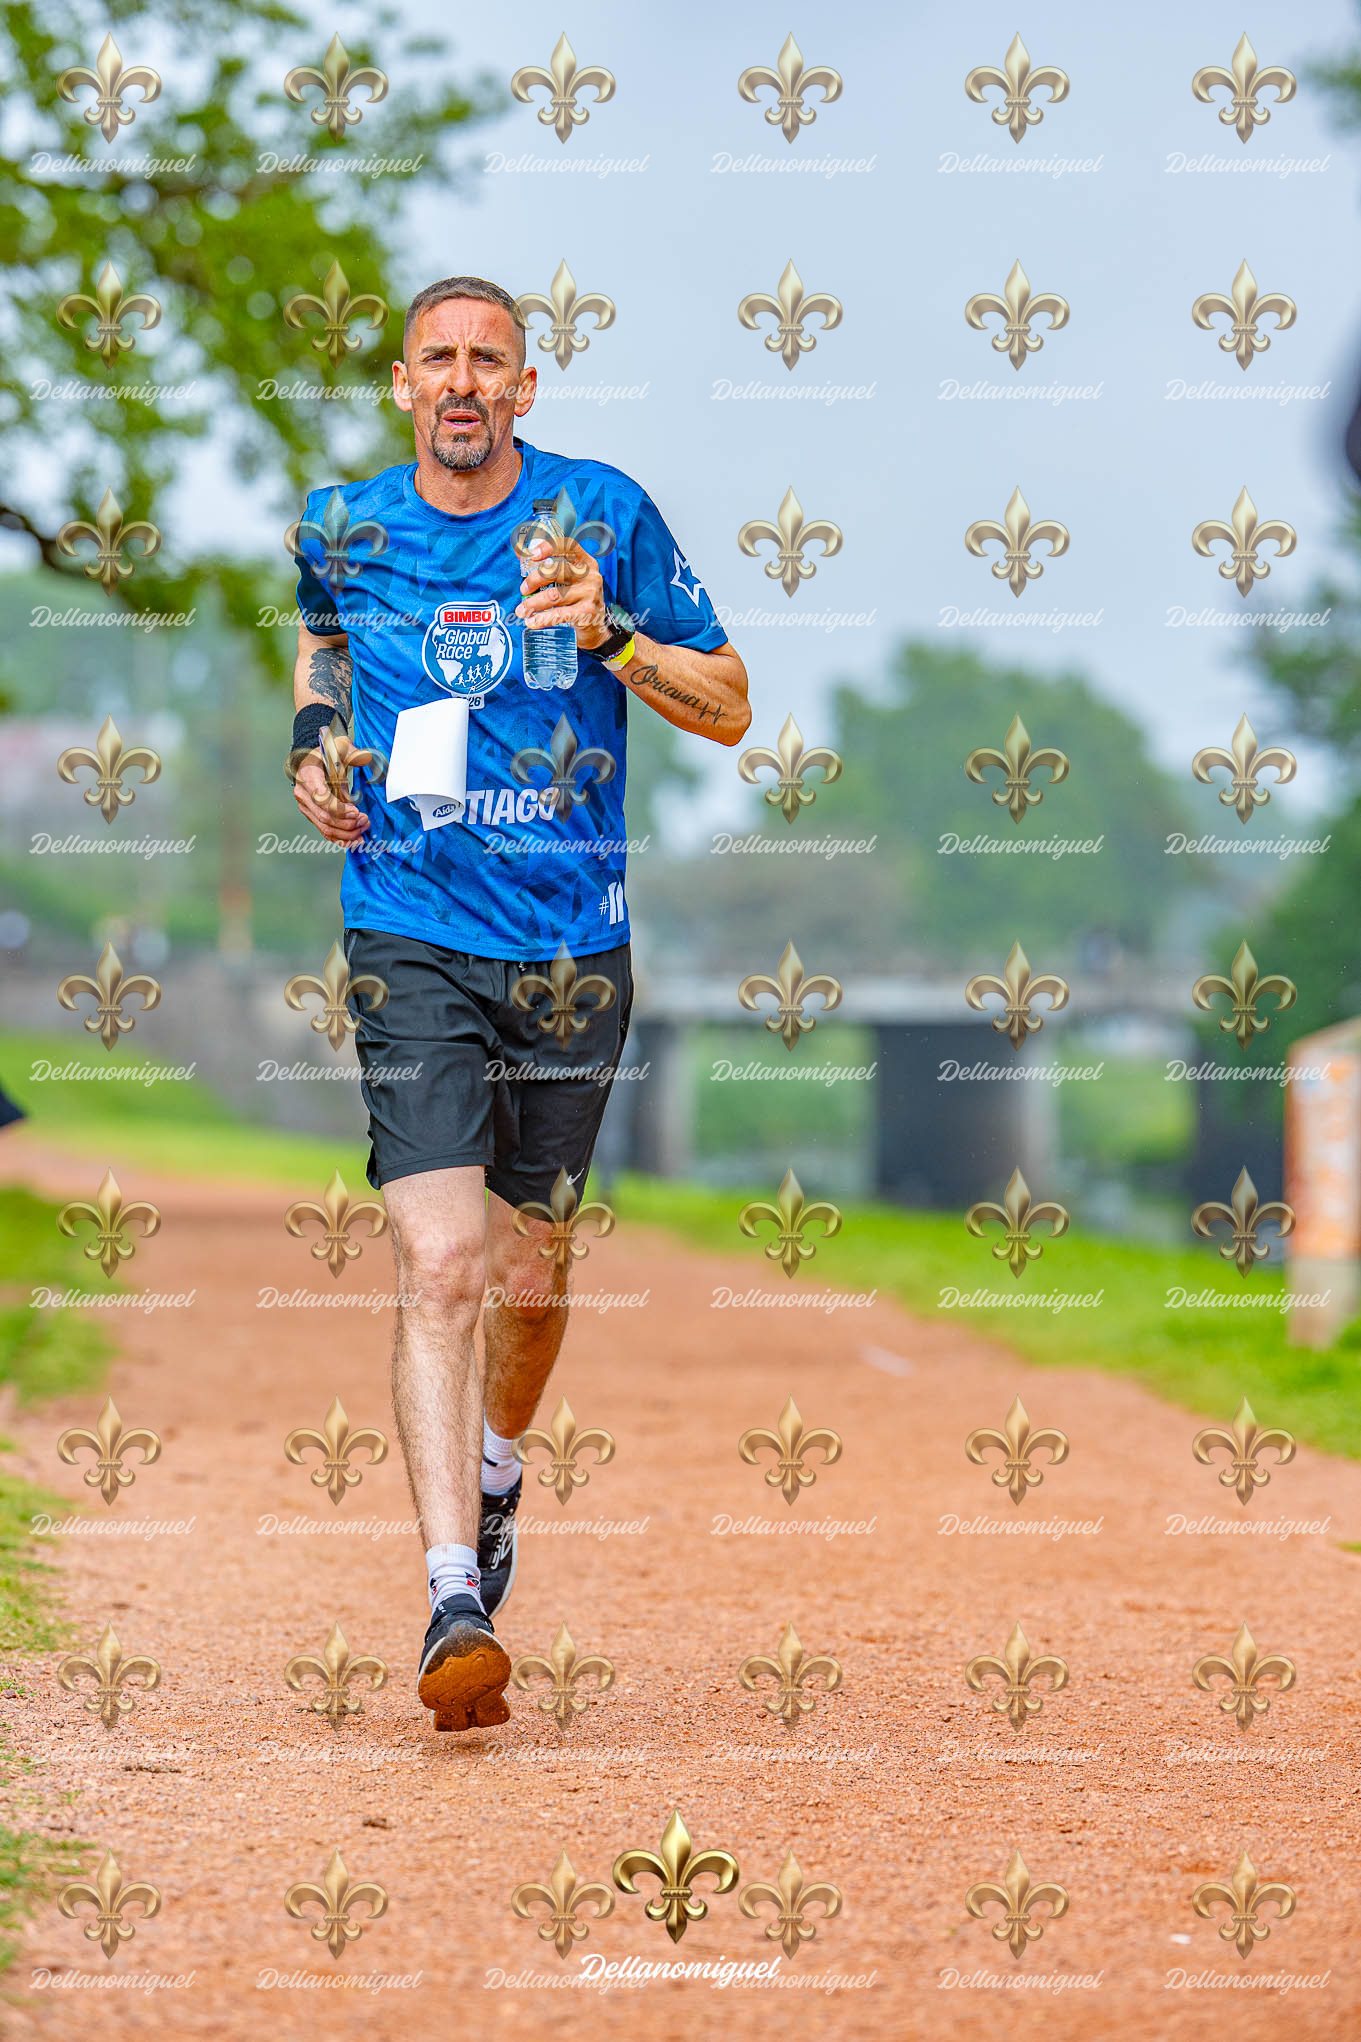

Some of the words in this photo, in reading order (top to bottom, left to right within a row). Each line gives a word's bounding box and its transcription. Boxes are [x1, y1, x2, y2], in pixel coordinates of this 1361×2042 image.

[443, 610, 492, 623] BIMBO
[445, 628, 491, 645] Global
[436, 643, 473, 660] Race
